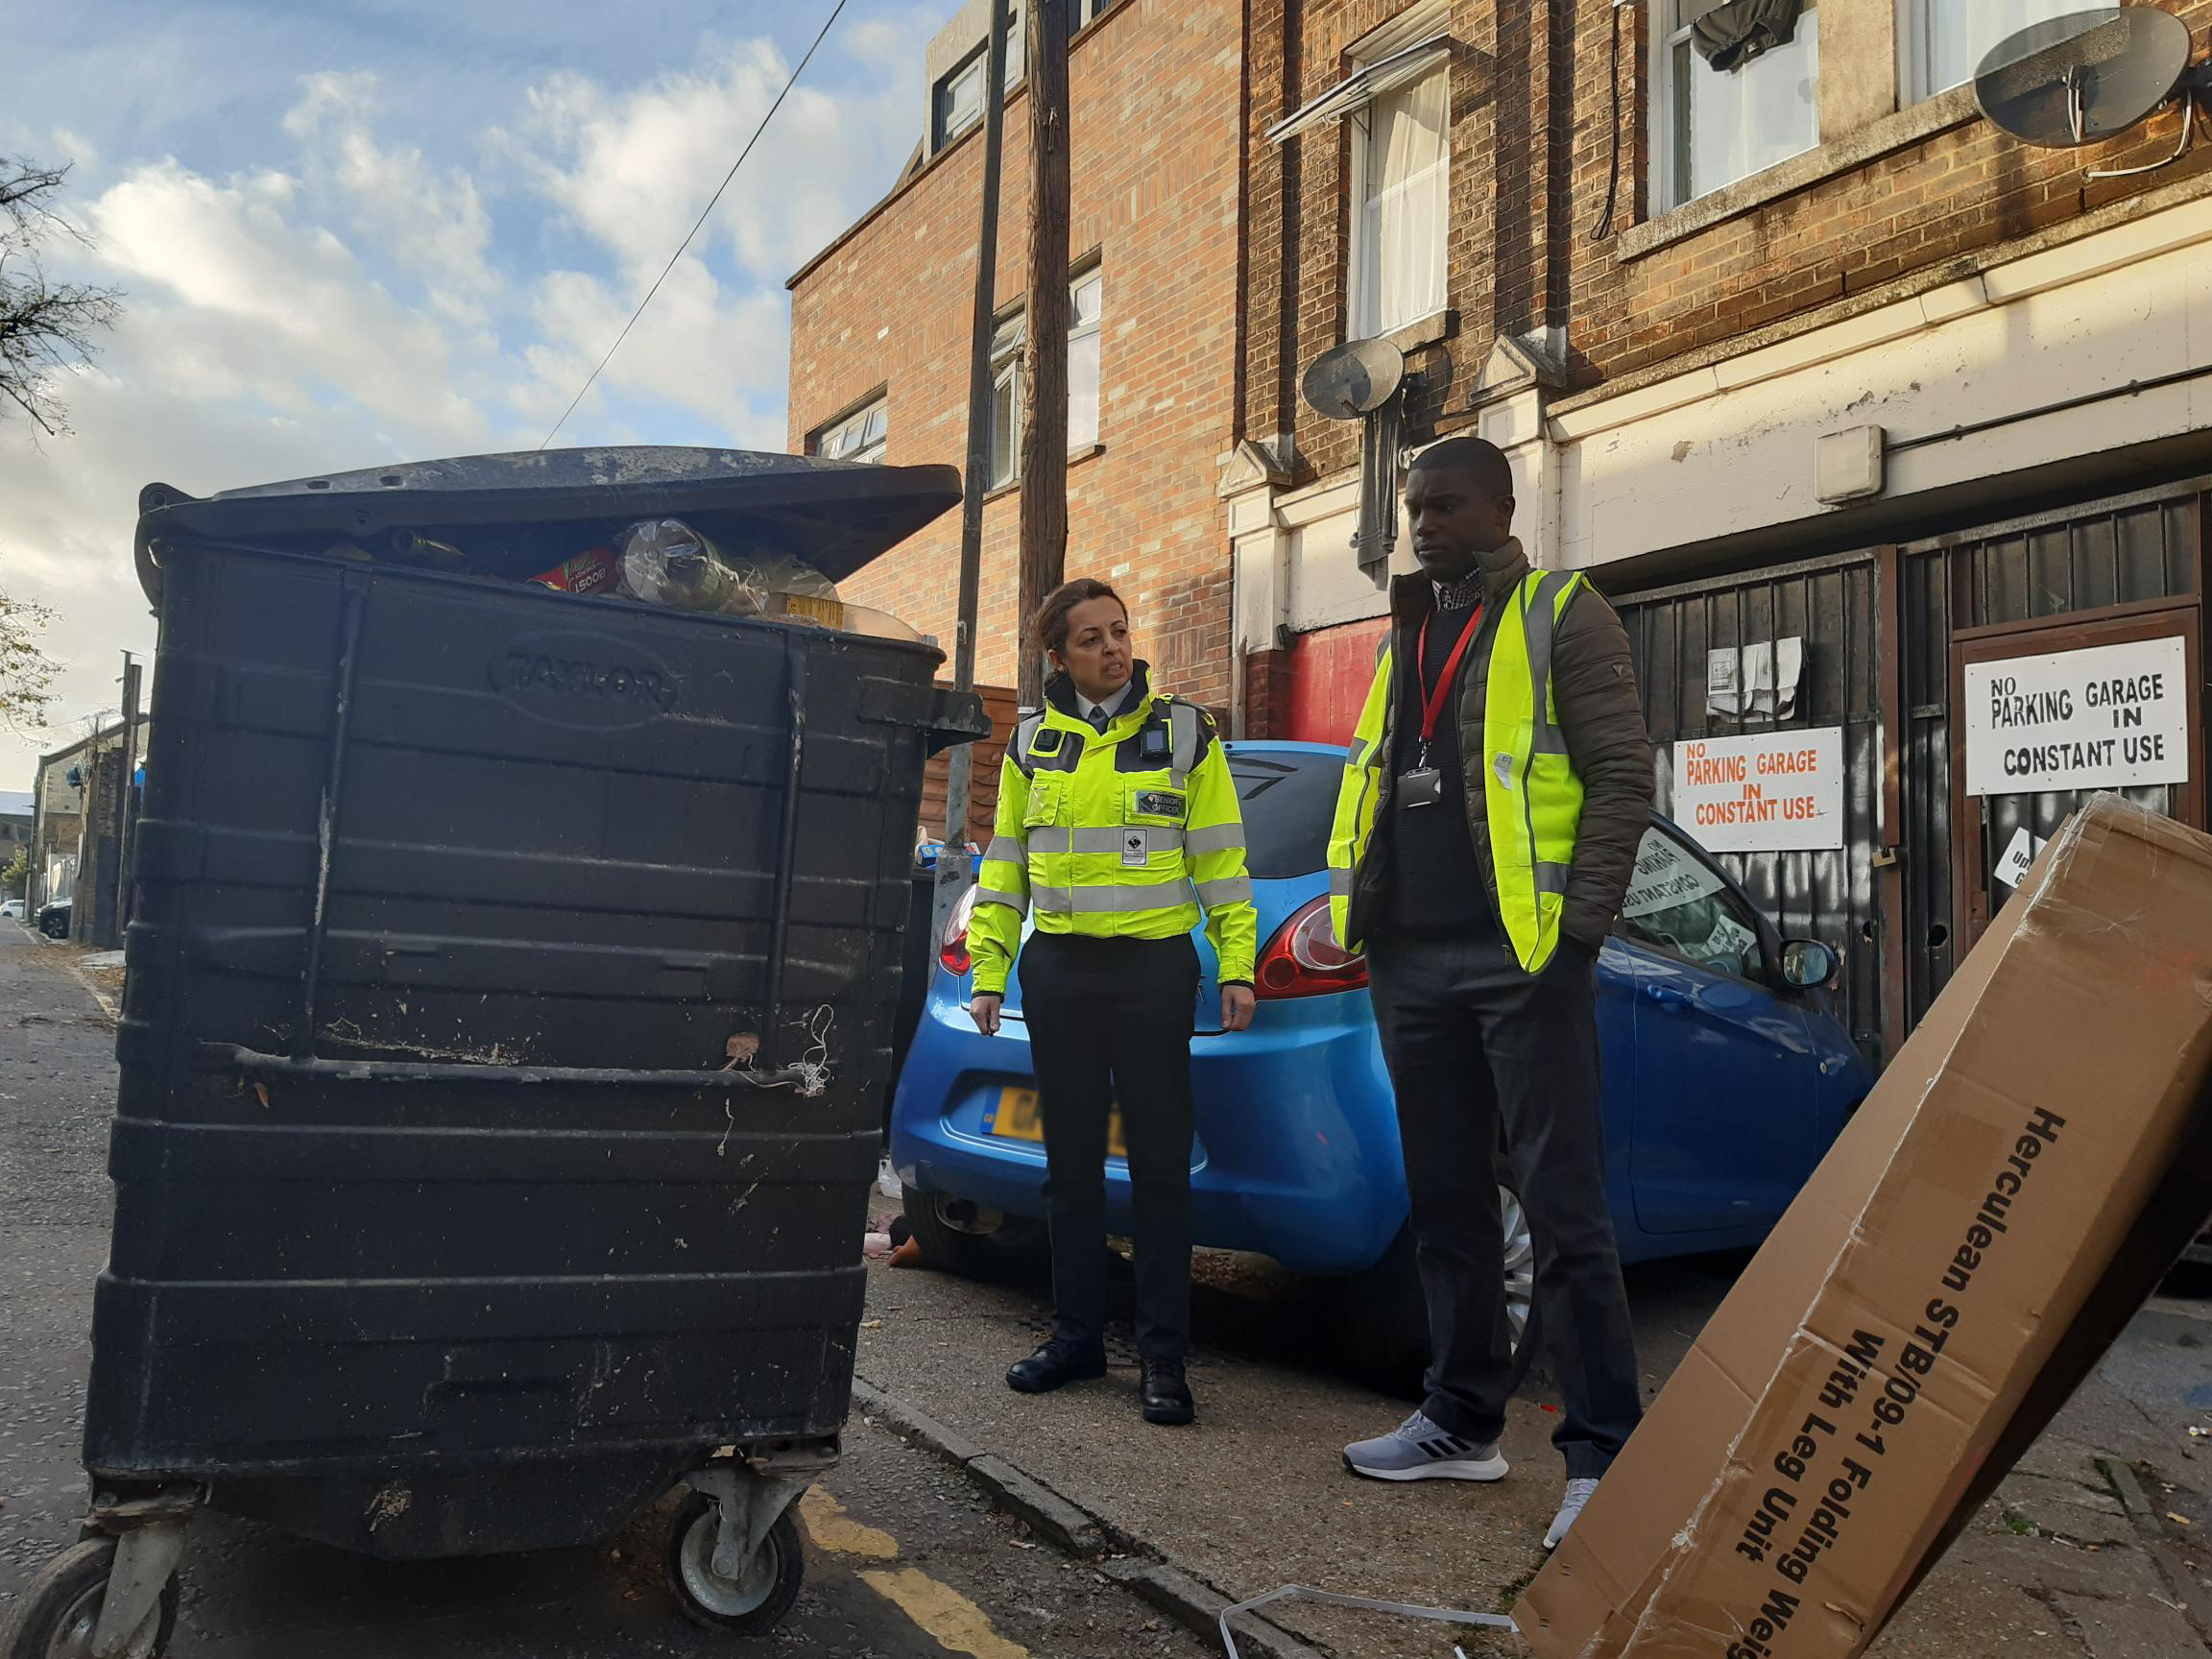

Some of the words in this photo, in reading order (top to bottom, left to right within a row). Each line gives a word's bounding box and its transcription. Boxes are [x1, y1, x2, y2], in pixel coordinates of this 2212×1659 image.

[574, 567, 607, 593] BOOST
[506, 651, 662, 705] TAYLOR
[1990, 677, 2016, 698] NO
[1991, 689, 2074, 730] PARKING
[2085, 673, 2164, 708] GARAGE
[2112, 707, 2142, 729] IN
[1686, 742, 1706, 759] NO
[1687, 755, 1746, 786] PARKING
[1756, 749, 1816, 775] GARAGE
[2004, 738, 2116, 776] CONSTANT
[2123, 733, 2165, 764] USE
[1151, 804, 1179, 814] OFFICER
[1154, 795, 1178, 805] SENIOR
[1695, 799, 1778, 826] CONSTANT
[1783, 796, 1815, 820] USE
[1743, 782, 1762, 800] IN
[1941, 1106, 2066, 1291] Herculean
[1818, 1329, 1886, 1408] With
[1855, 1298, 1959, 1455] STB/09-1
[1774, 1412, 1838, 1482] Leg
[1736, 1488, 1797, 1562] Unit
[1776, 1456, 1872, 1584] Folding
